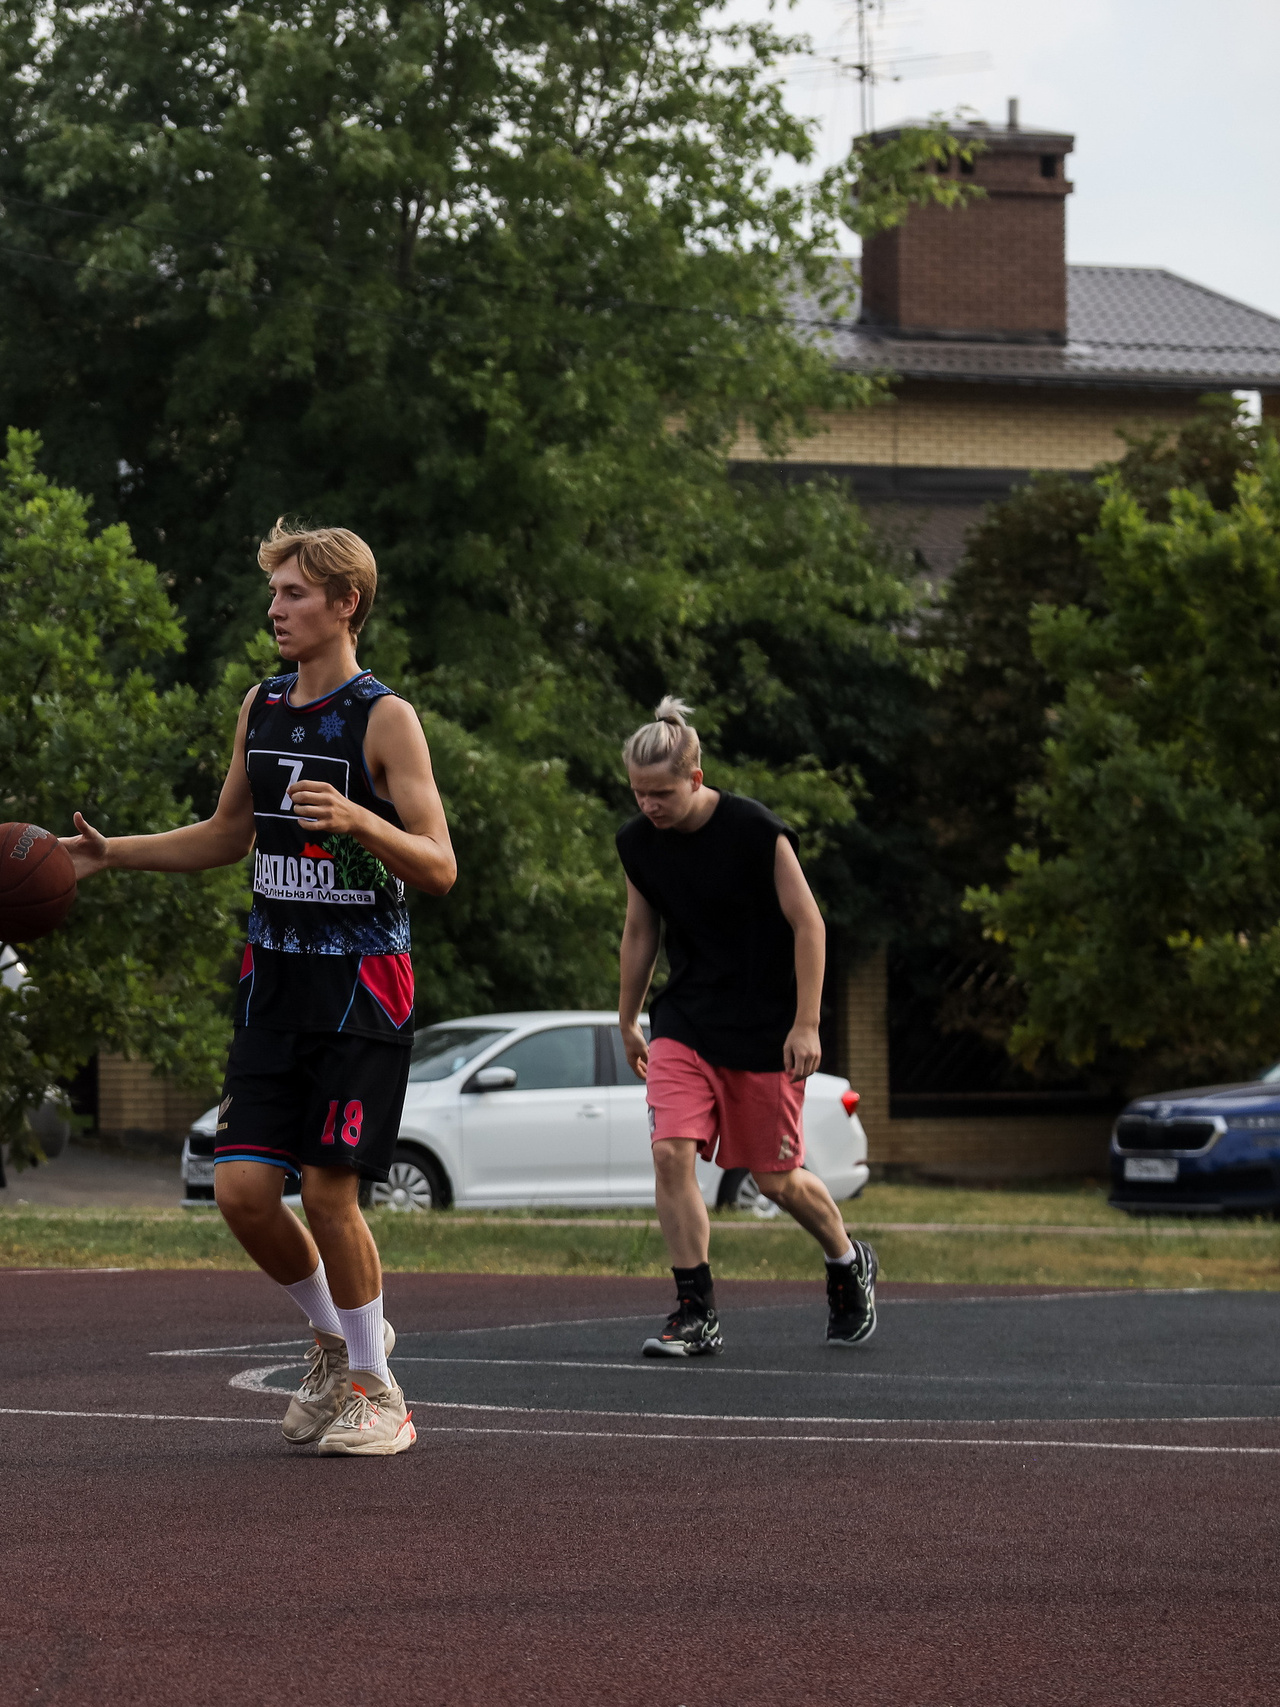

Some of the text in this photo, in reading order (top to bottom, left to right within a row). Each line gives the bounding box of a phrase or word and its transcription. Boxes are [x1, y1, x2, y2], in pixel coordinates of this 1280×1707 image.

[277, 757, 304, 811] 7
[10, 824, 52, 860] lson
[318, 890, 372, 903] Москва
[321, 1100, 364, 1148] 18
